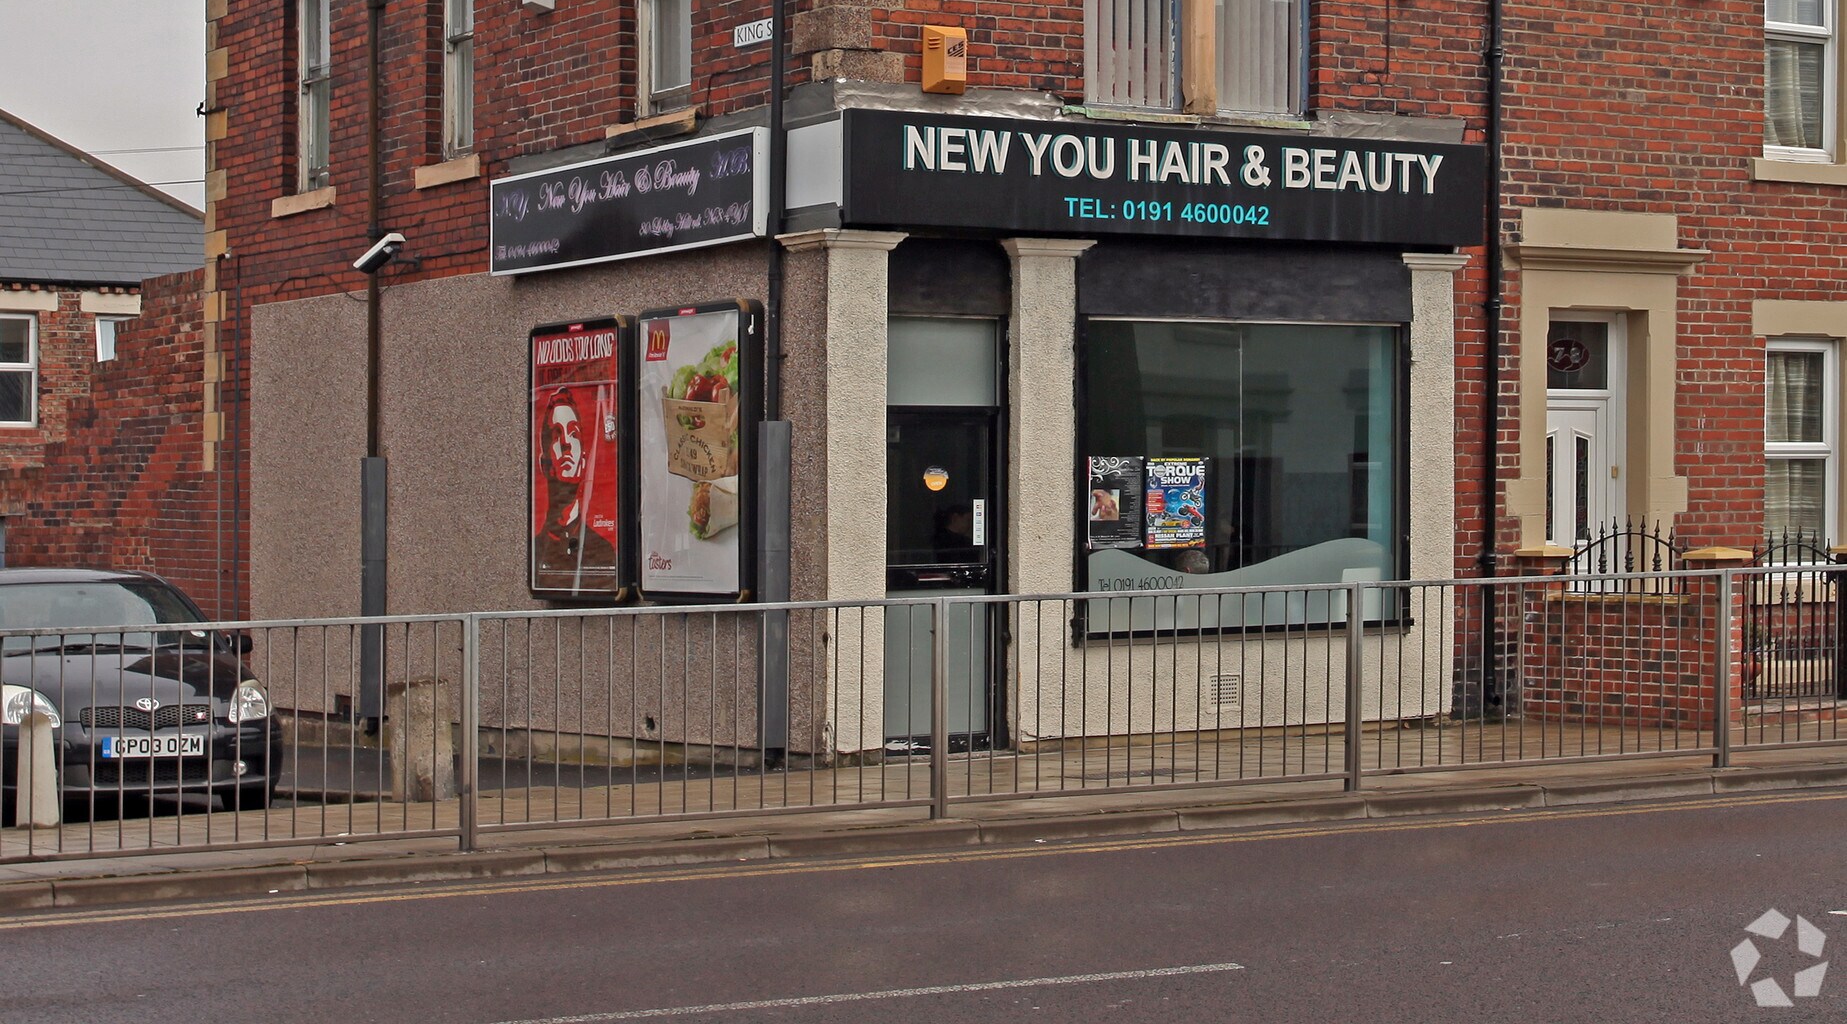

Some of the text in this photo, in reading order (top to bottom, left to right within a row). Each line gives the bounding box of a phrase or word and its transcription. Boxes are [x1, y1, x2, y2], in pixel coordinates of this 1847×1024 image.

[737, 23, 763, 44] KING
[947, 41, 964, 54] CES
[904, 125, 1443, 194] NEW YOU HAIR & BEAUTY
[537, 181, 565, 211] New
[568, 176, 596, 213] You
[599, 170, 631, 201] Hair
[654, 159, 700, 196] Beauty
[1064, 197, 1269, 225] TEL: 0191 4600042
[537, 332, 615, 364] NO ODDS TOO LONG
[690, 434, 716, 473] CHICKEN
[1146, 465, 1206, 477] TORQUE
[1161, 476, 1191, 484] SHOW
[1099, 576, 1184, 591] Tel 0191 4600042
